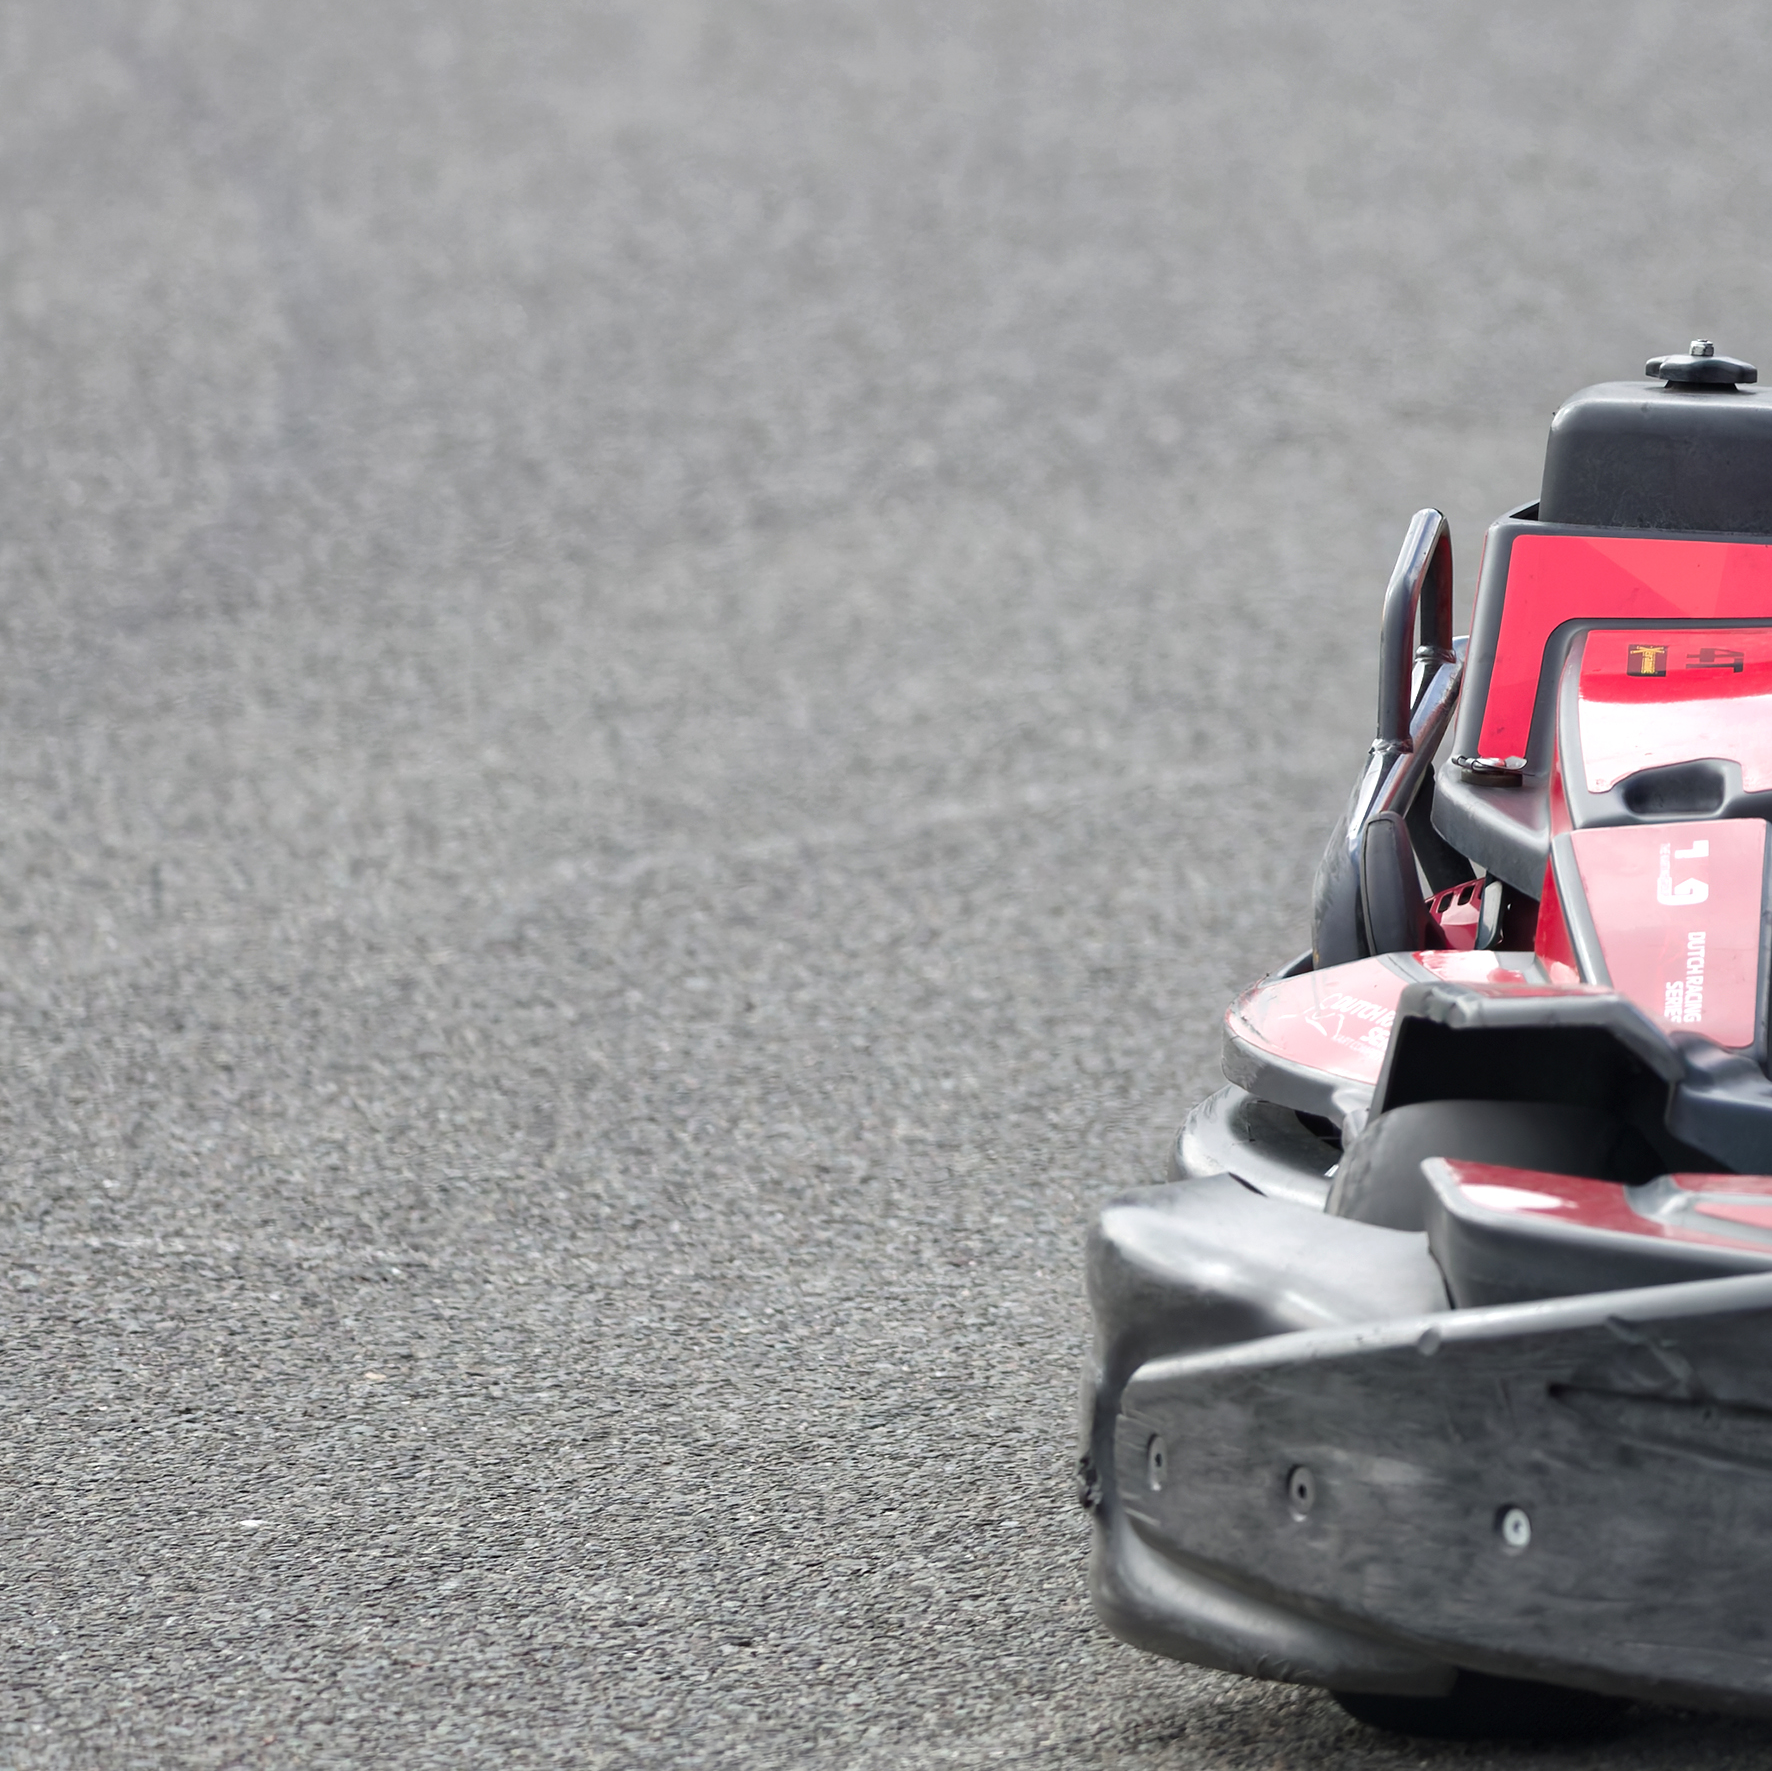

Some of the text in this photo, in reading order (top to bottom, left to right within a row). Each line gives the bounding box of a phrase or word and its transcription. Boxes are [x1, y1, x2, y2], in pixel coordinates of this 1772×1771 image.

[1683, 931, 1706, 1024] DUTCH RACING
[1331, 995, 1388, 1024] DUTCH
